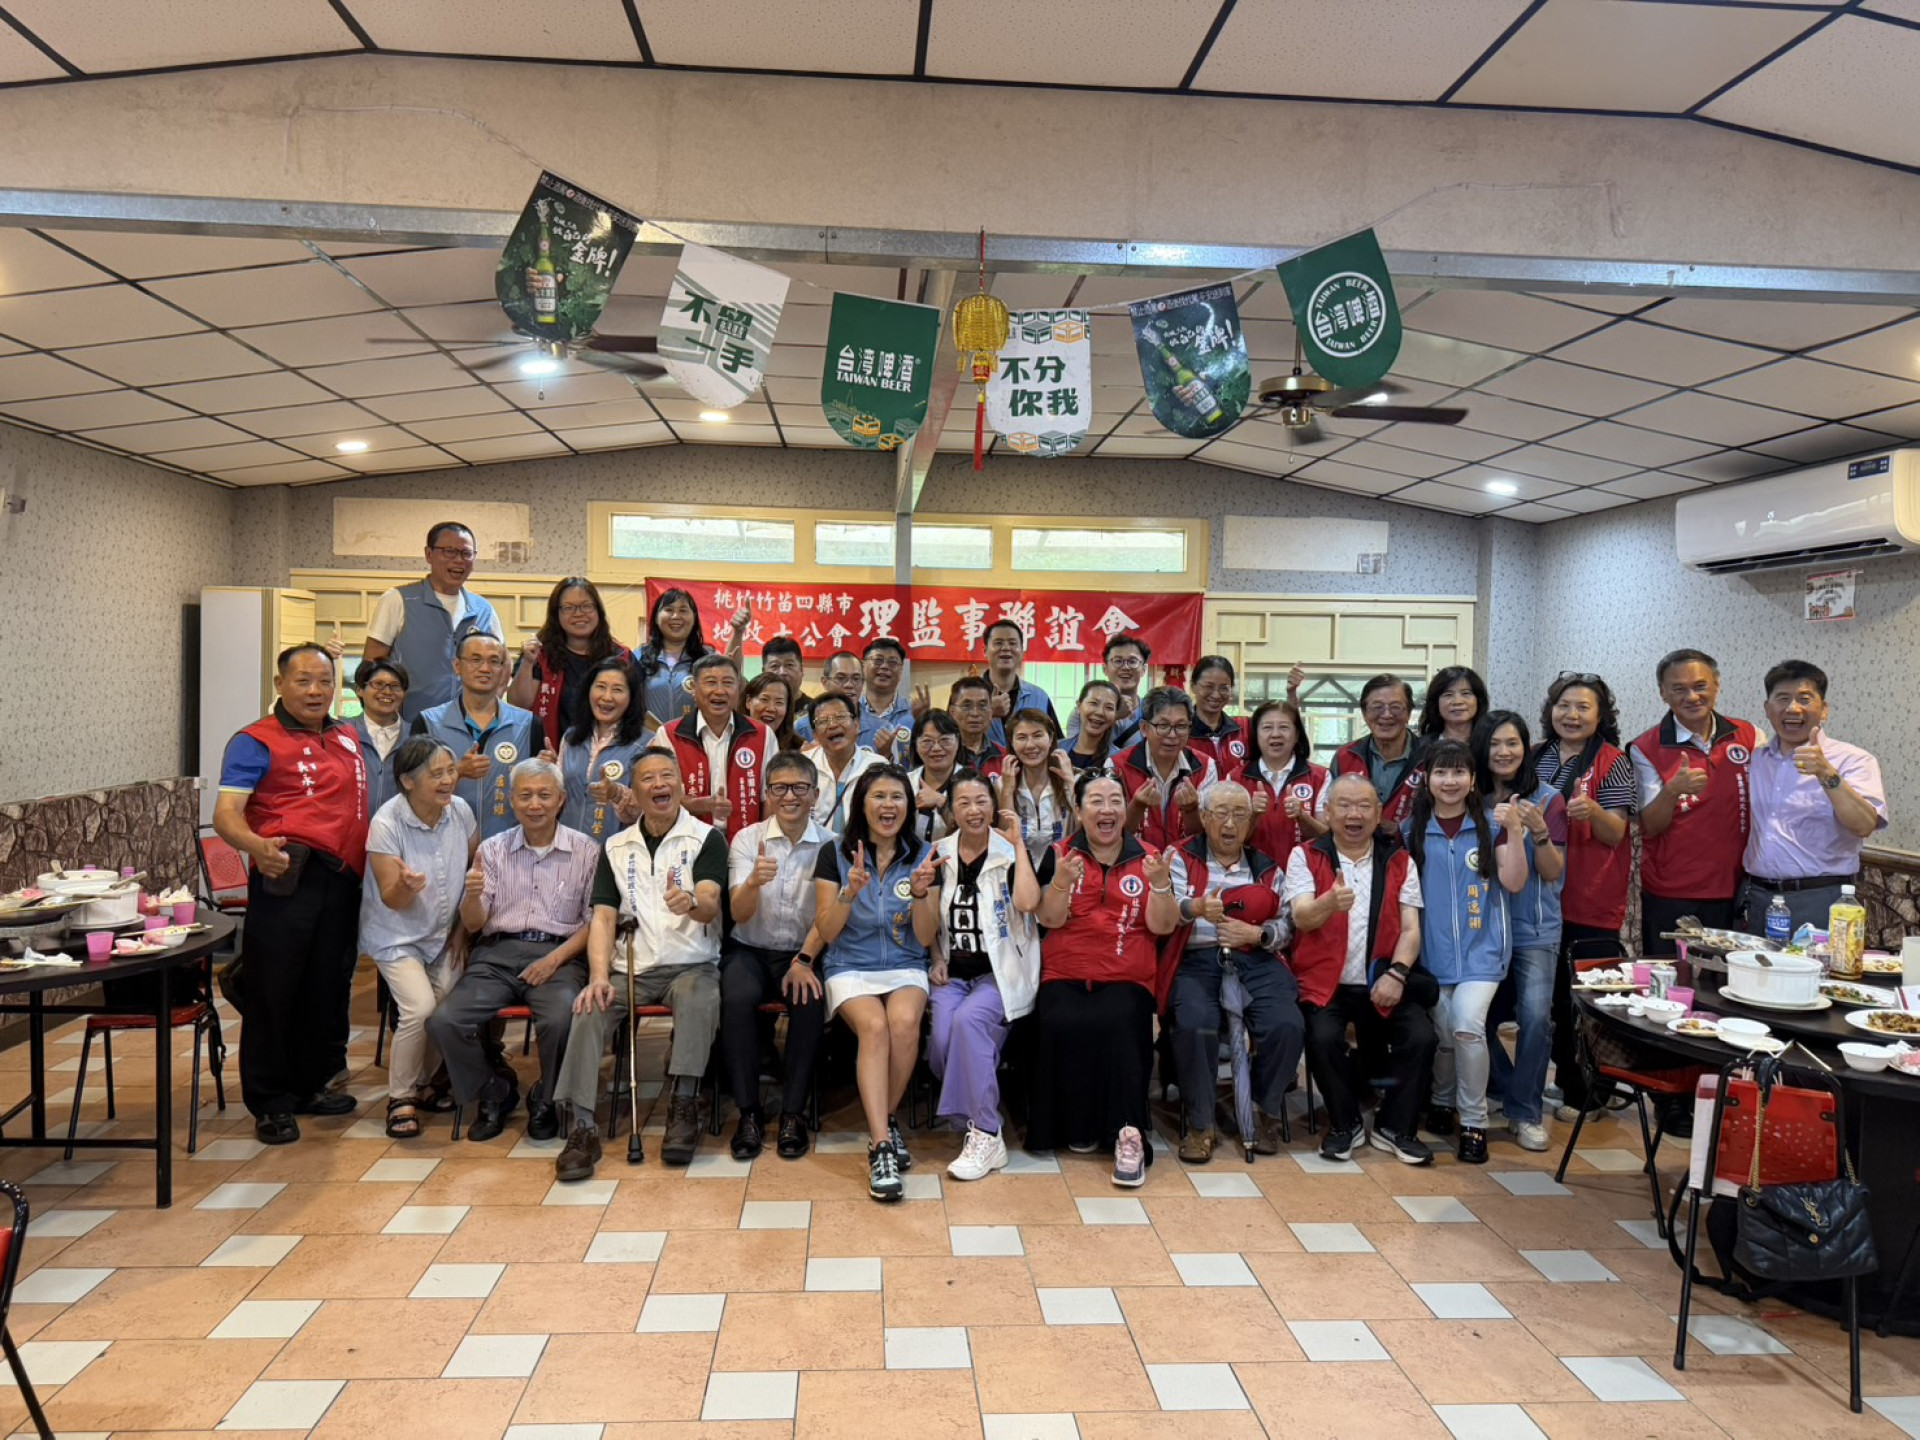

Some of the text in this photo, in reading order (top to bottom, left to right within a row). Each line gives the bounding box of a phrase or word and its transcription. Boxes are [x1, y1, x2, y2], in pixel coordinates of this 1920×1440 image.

[1315, 278, 1369, 309] TAIWAN BEER
[1314, 289, 1381, 339] 台灣啤酒
[1325, 319, 1380, 350] TAIWAN BEER
[684, 336, 754, 374] 一手
[838, 344, 915, 382] 台灣啤酒
[1001, 355, 1066, 384] 不分
[836, 370, 911, 393] TAIWAN BEER
[1009, 387, 1079, 417] 你我
[713, 588, 855, 616] 桃竹竹苗四縣市
[712, 620, 852, 649] 地政士公會
[857, 596, 1140, 652] 理監事聯誼會
